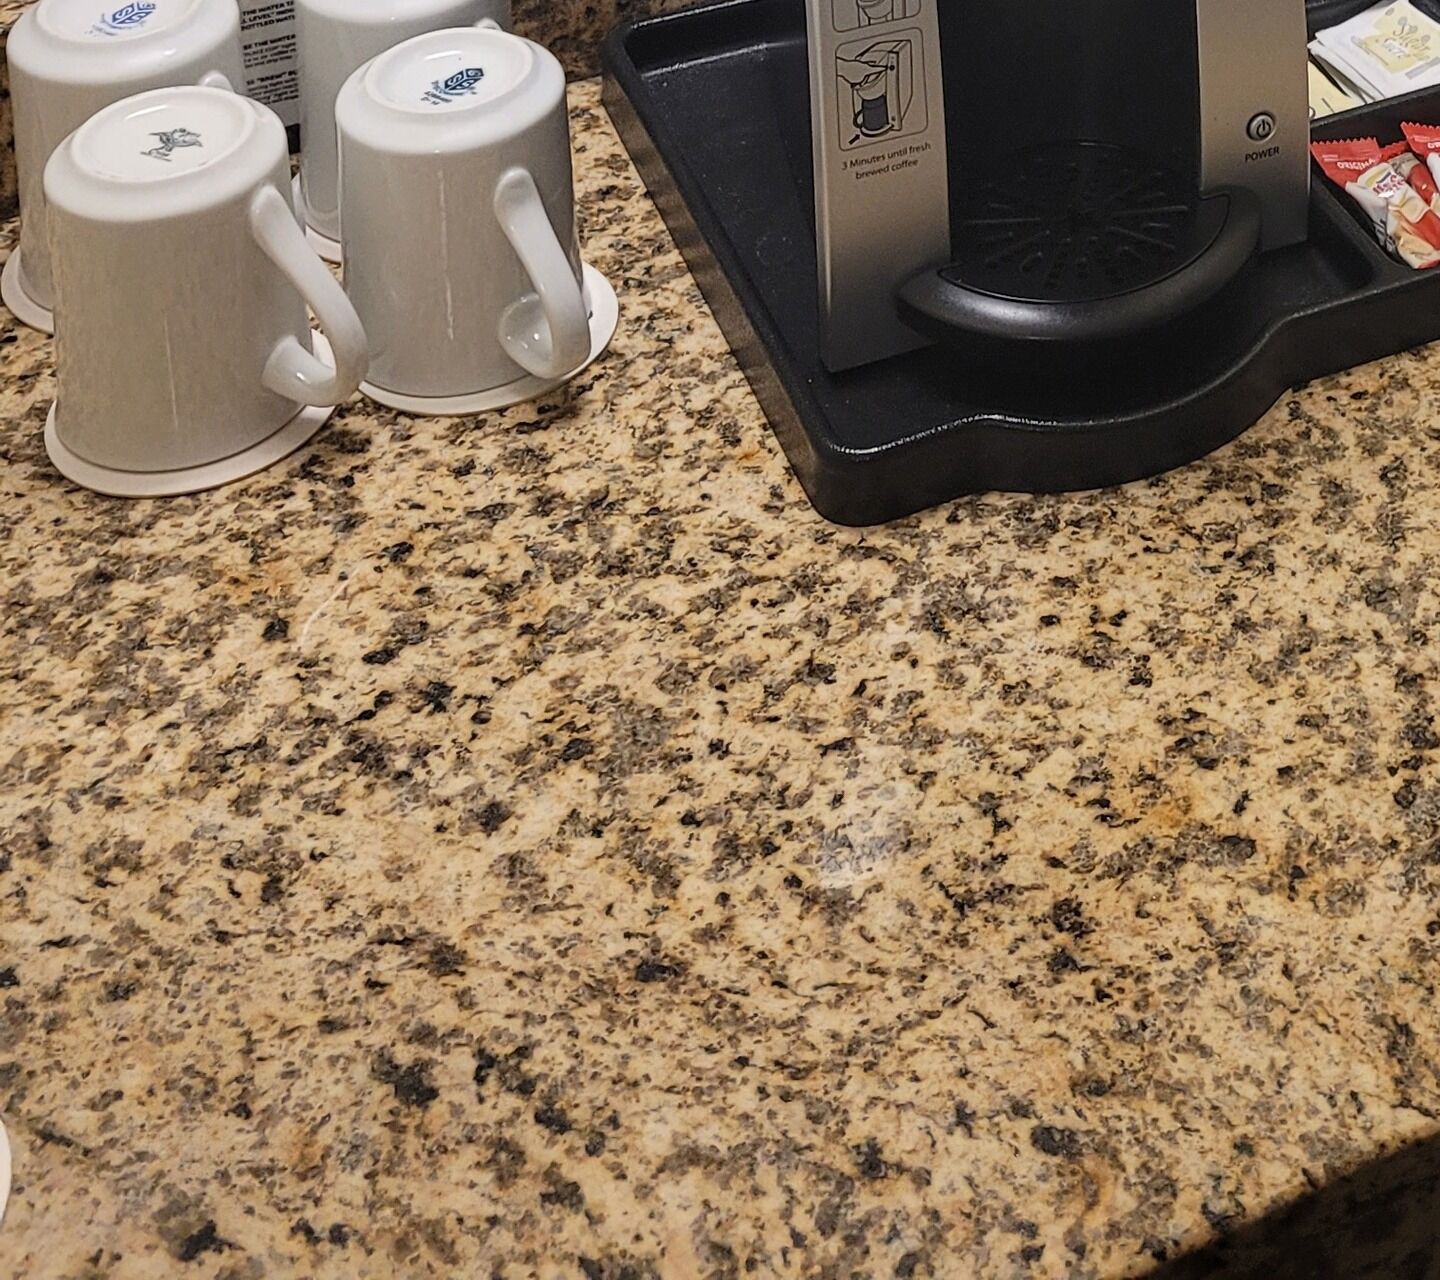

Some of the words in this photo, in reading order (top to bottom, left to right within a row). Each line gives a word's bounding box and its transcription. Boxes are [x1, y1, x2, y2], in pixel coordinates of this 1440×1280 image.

[841, 161, 847, 170] 3
[850, 154, 885, 168] Minutes
[887, 147, 907, 159] until
[909, 142, 931, 154] fresh
[1245, 146, 1280, 163] POWER
[855, 165, 889, 180] brewed
[891, 159, 919, 171] coffee
